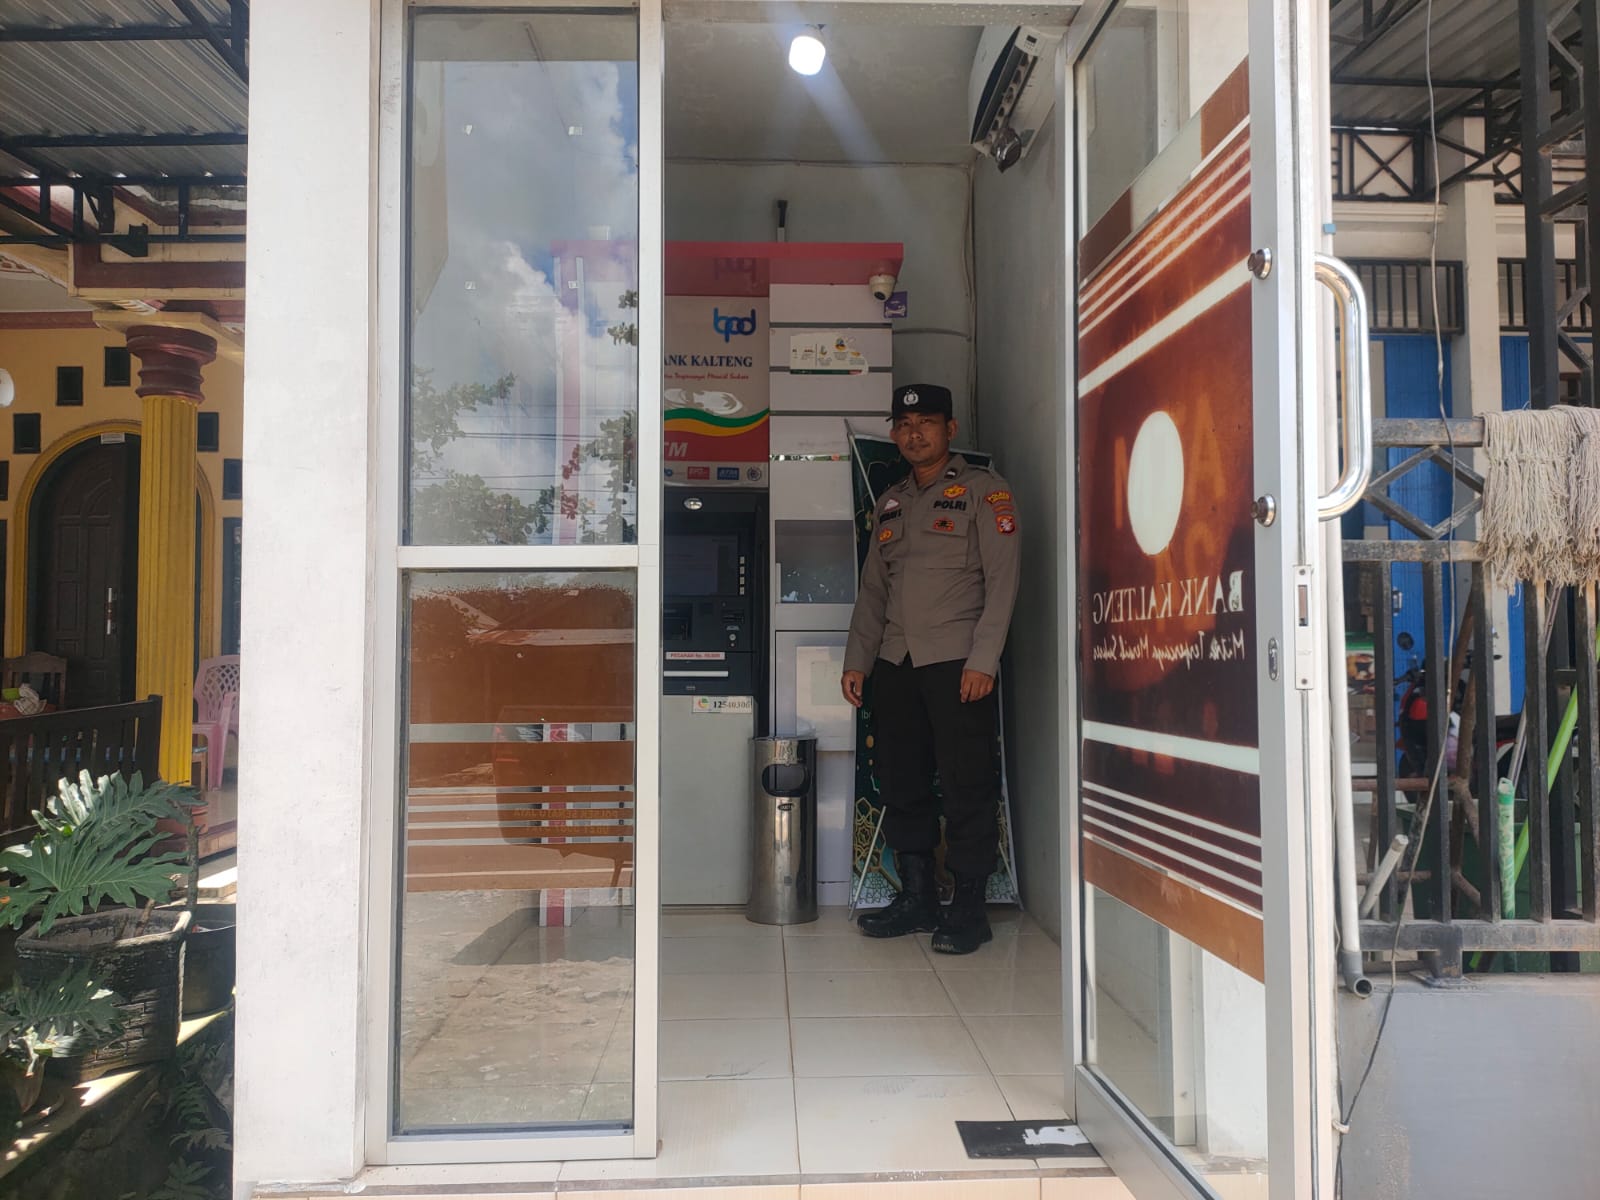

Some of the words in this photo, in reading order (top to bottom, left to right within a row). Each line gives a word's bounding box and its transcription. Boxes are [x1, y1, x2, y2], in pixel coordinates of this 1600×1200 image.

[713, 307, 757, 343] bpd
[691, 355, 753, 368] KALTENG
[933, 500, 967, 512] POLRI
